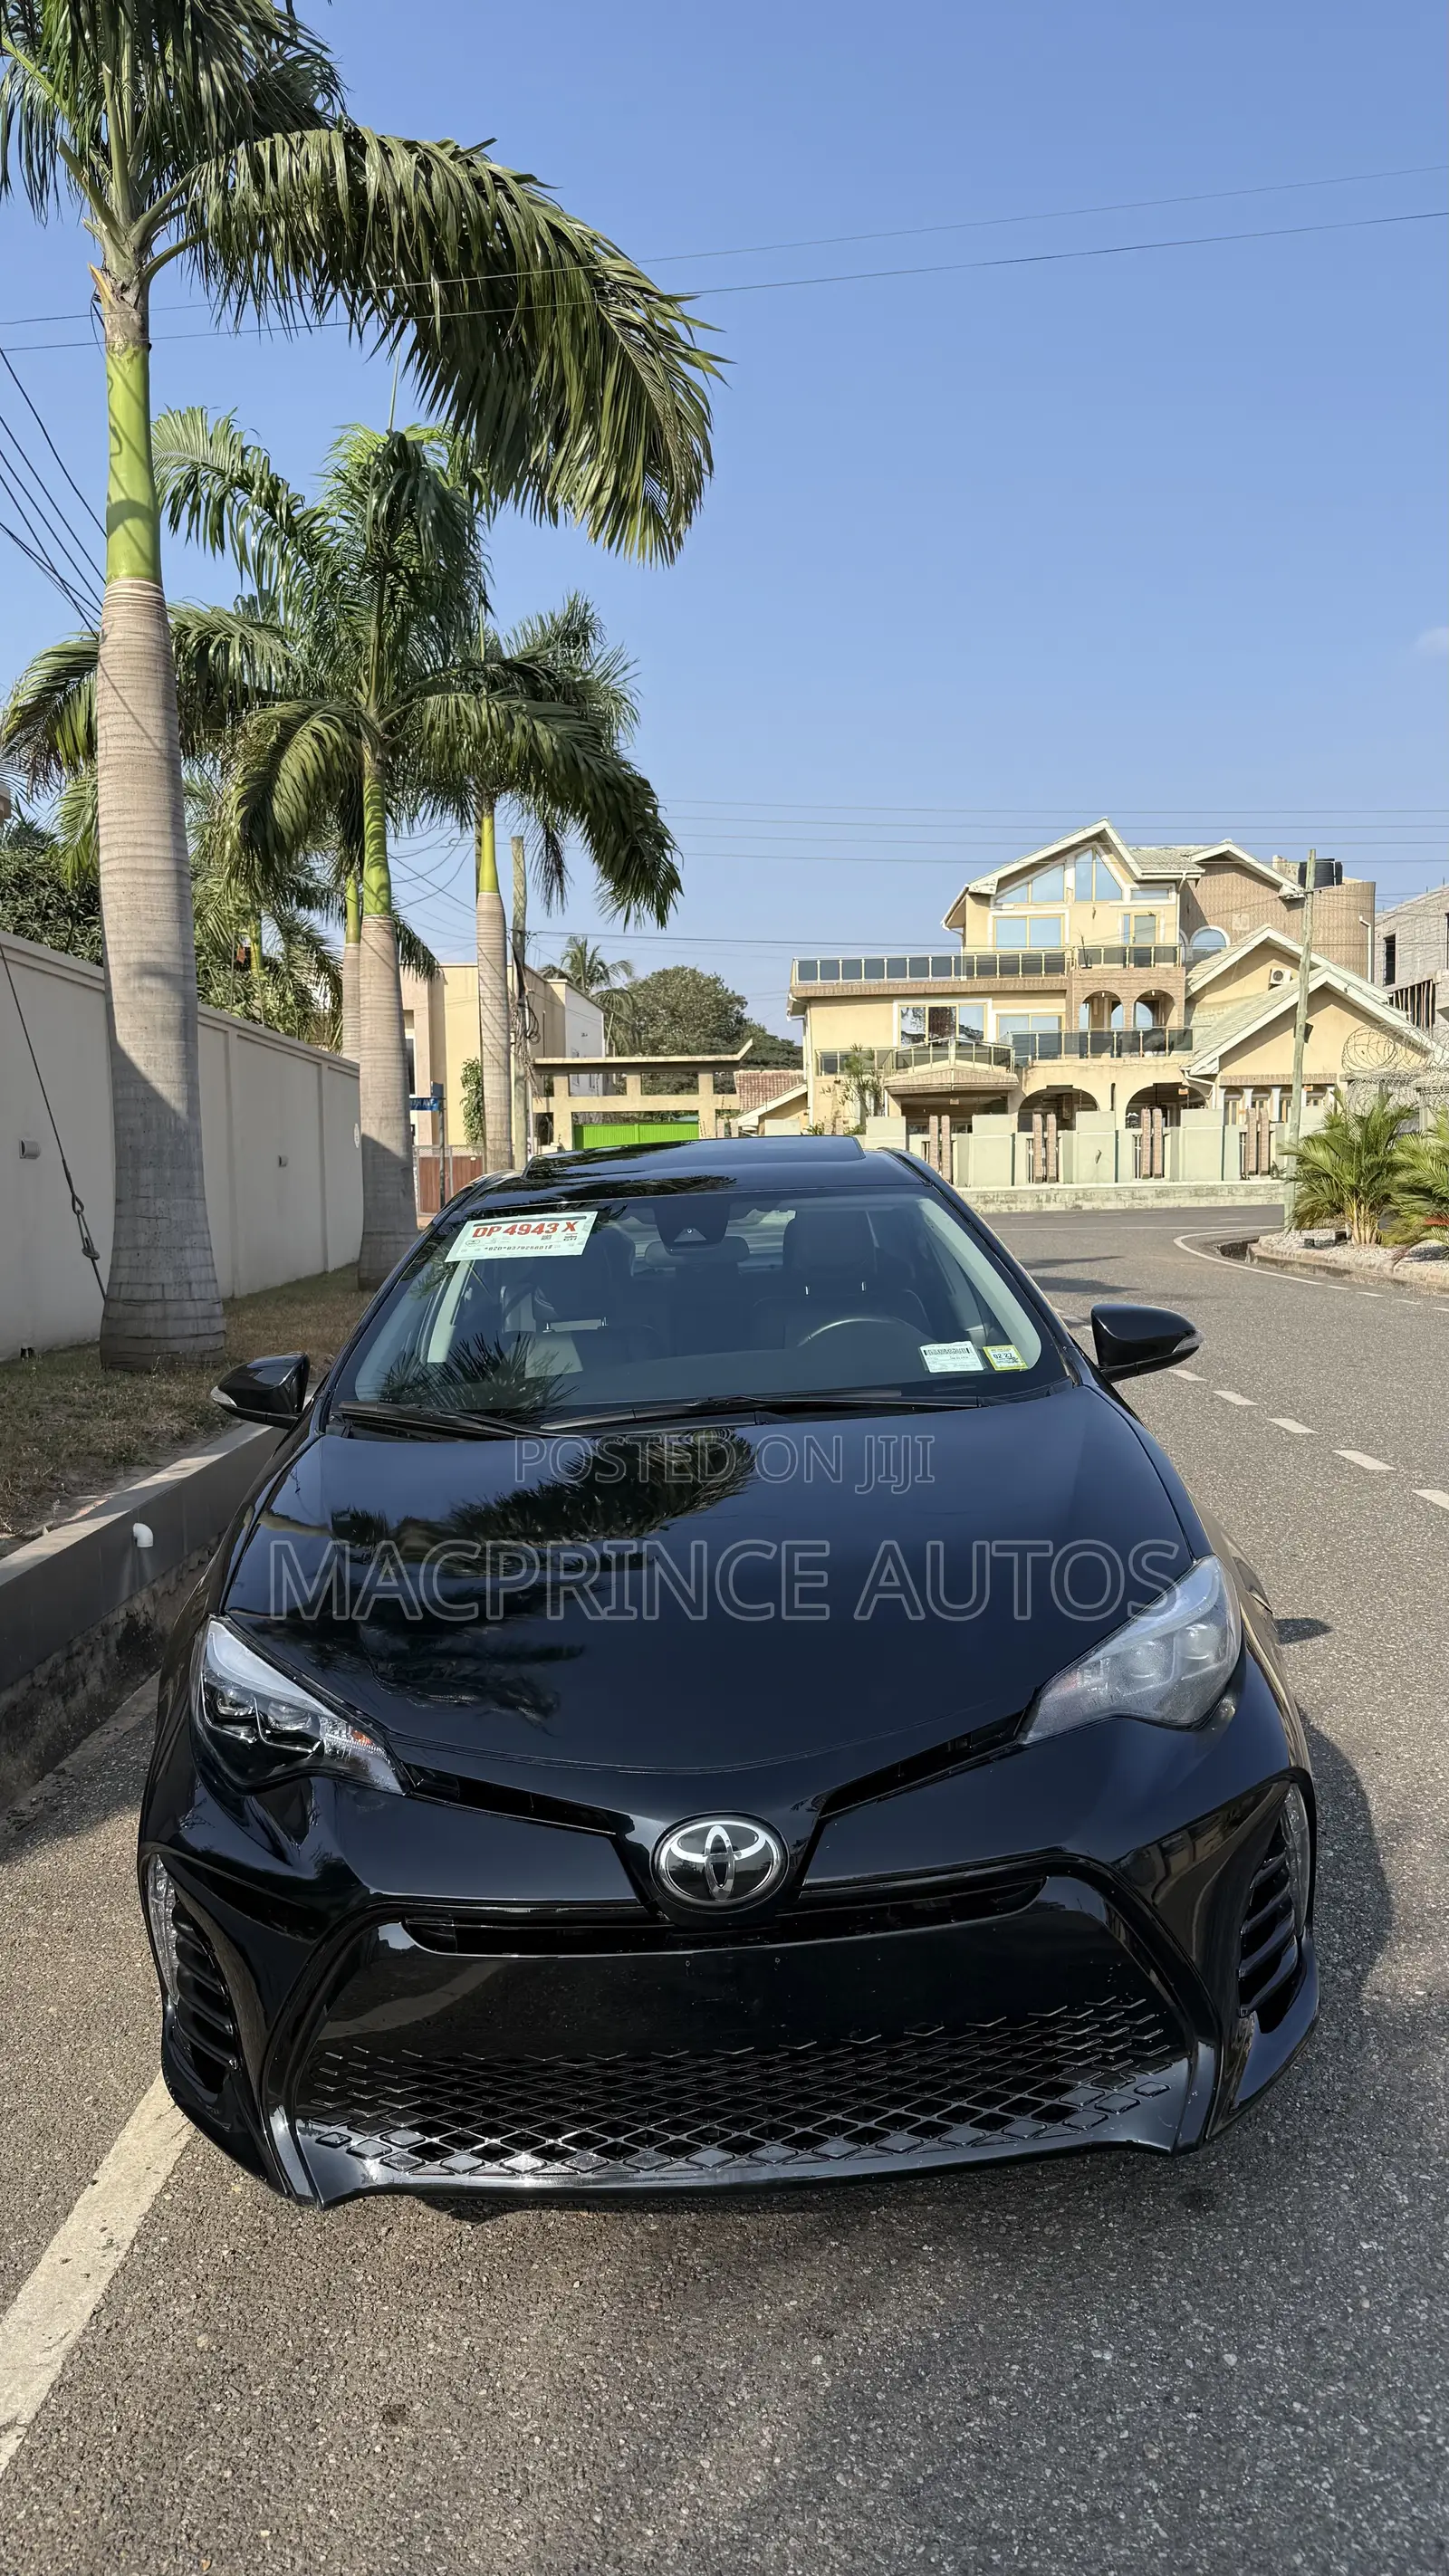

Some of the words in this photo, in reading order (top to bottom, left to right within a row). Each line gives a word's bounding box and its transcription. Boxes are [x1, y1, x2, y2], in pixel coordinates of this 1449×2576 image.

[472, 1226, 502, 1238] DP
[503, 1222, 560, 1236] 4943
[561, 1221, 579, 1232] X
